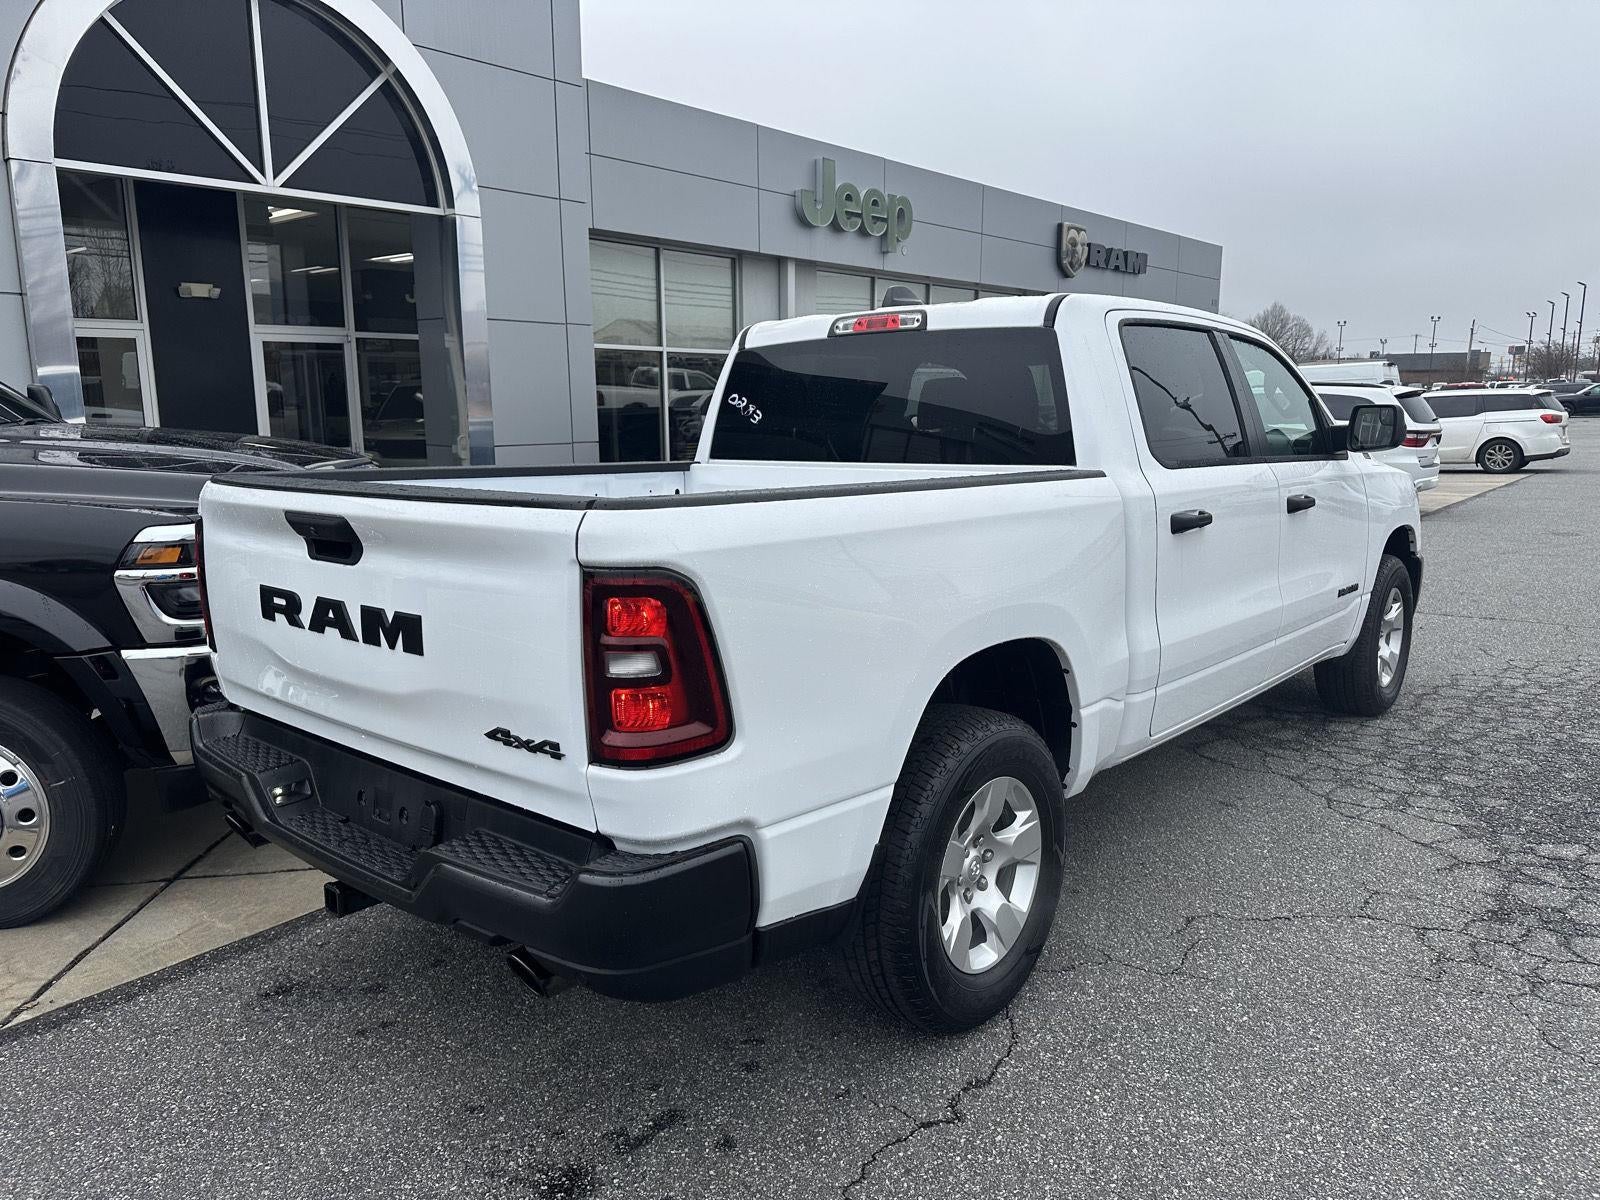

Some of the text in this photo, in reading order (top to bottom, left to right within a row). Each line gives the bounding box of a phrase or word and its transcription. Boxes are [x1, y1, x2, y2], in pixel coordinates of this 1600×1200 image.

[794, 157, 913, 254] Jeep
[1087, 242, 1147, 275] RAM
[259, 584, 424, 657] RAM
